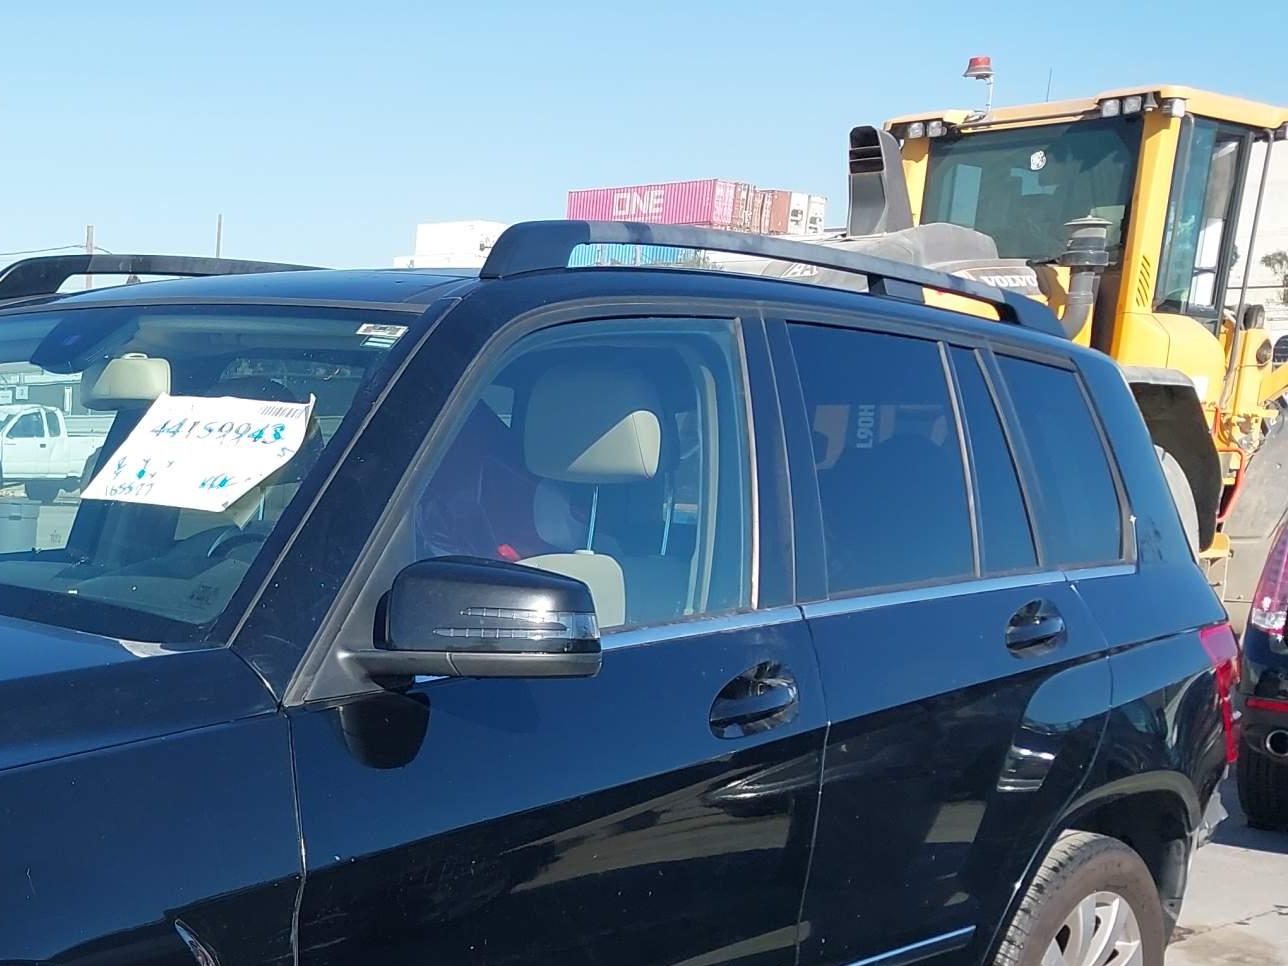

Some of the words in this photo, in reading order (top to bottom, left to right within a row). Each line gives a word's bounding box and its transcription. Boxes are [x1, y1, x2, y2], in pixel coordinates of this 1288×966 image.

[612, 190, 664, 217] ONE
[980, 274, 1038, 288] VOLVO
[150, 417, 286, 444] 44159943
[856, 404, 876, 449] L90H
